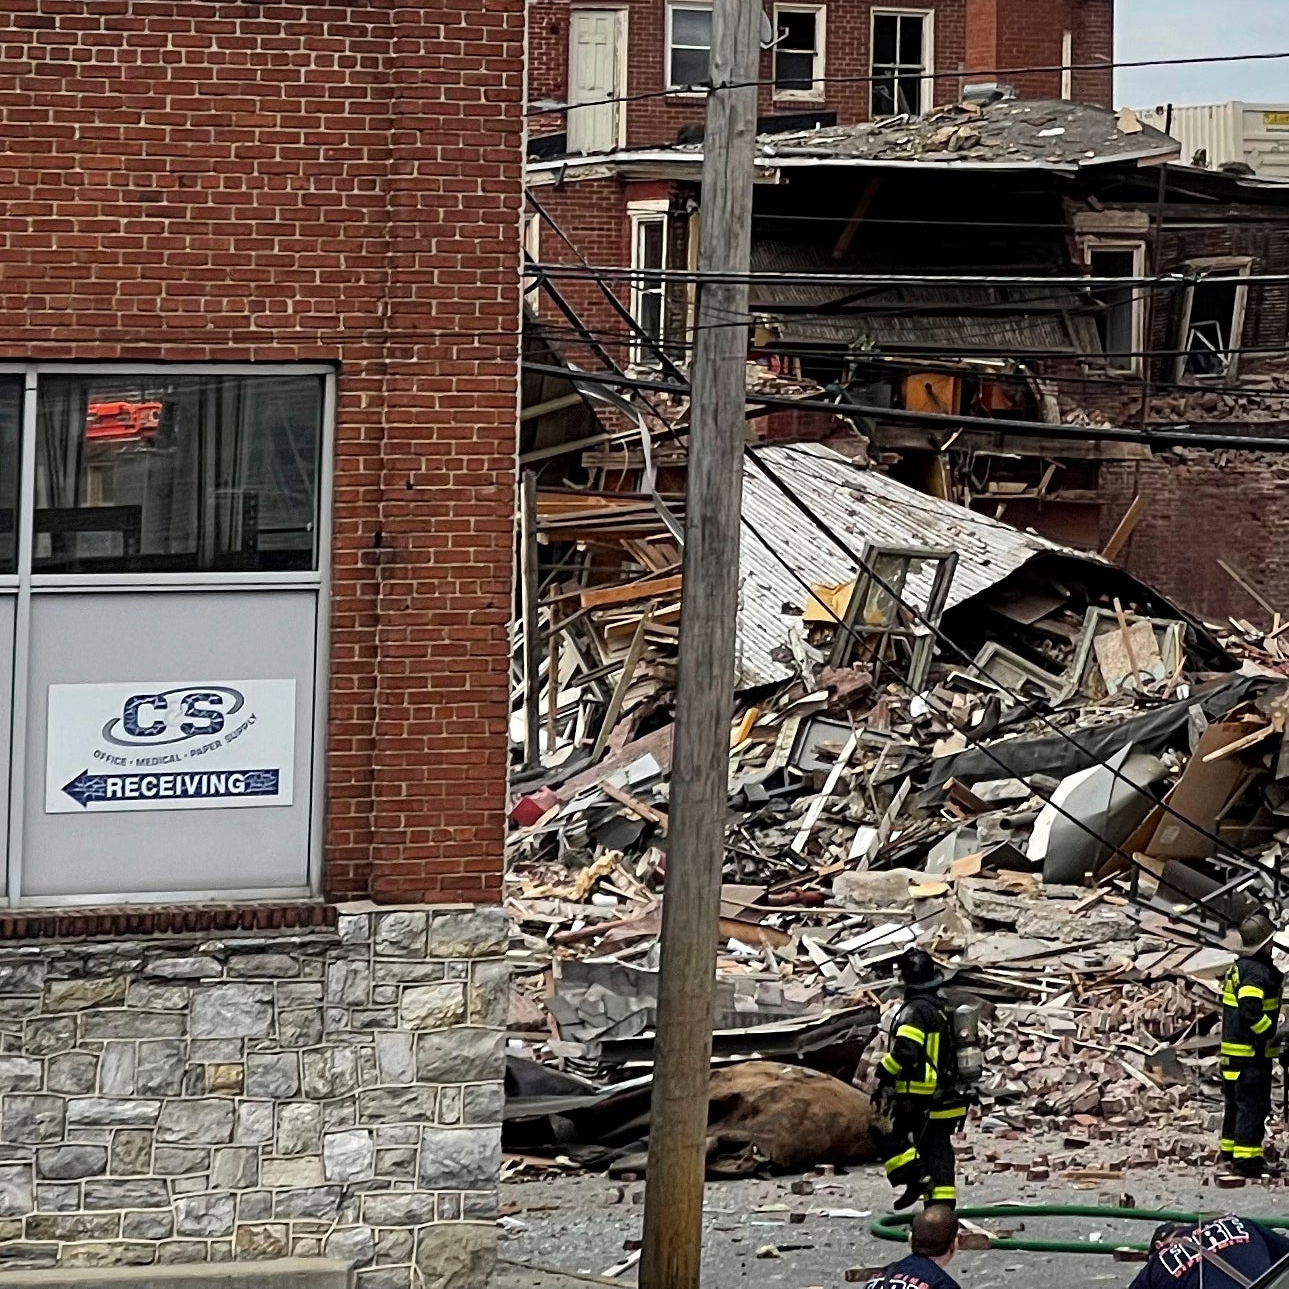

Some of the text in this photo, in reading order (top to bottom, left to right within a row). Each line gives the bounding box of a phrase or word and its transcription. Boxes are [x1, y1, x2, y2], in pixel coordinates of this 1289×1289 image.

[93, 712, 258, 767] OFFICE MEDICAL PAPER SUPPLY
[106, 773, 246, 798] RECEIVING
